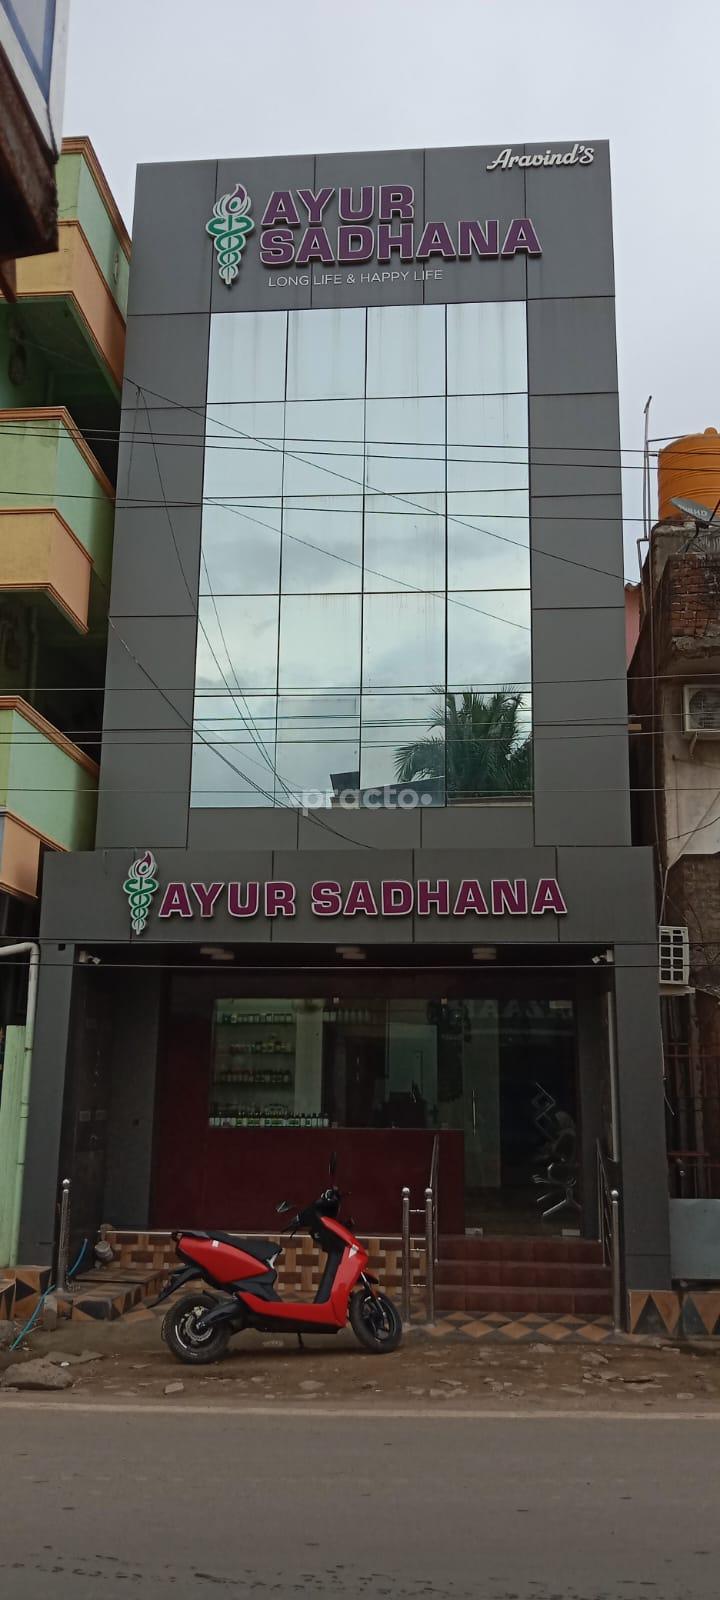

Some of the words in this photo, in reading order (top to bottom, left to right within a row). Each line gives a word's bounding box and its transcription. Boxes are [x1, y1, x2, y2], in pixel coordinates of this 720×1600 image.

[261, 184, 415, 226] AYUR
[259, 218, 543, 266] SADHANA
[268, 275, 310, 288] LONG
[313, 274, 344, 286] LIFE
[346, 272, 357, 285] &
[360, 271, 410, 284] HAPPY
[413, 269, 444, 282] LIFE
[158, 880, 297, 919] AYUR
[311, 878, 569, 918] SADHANA
